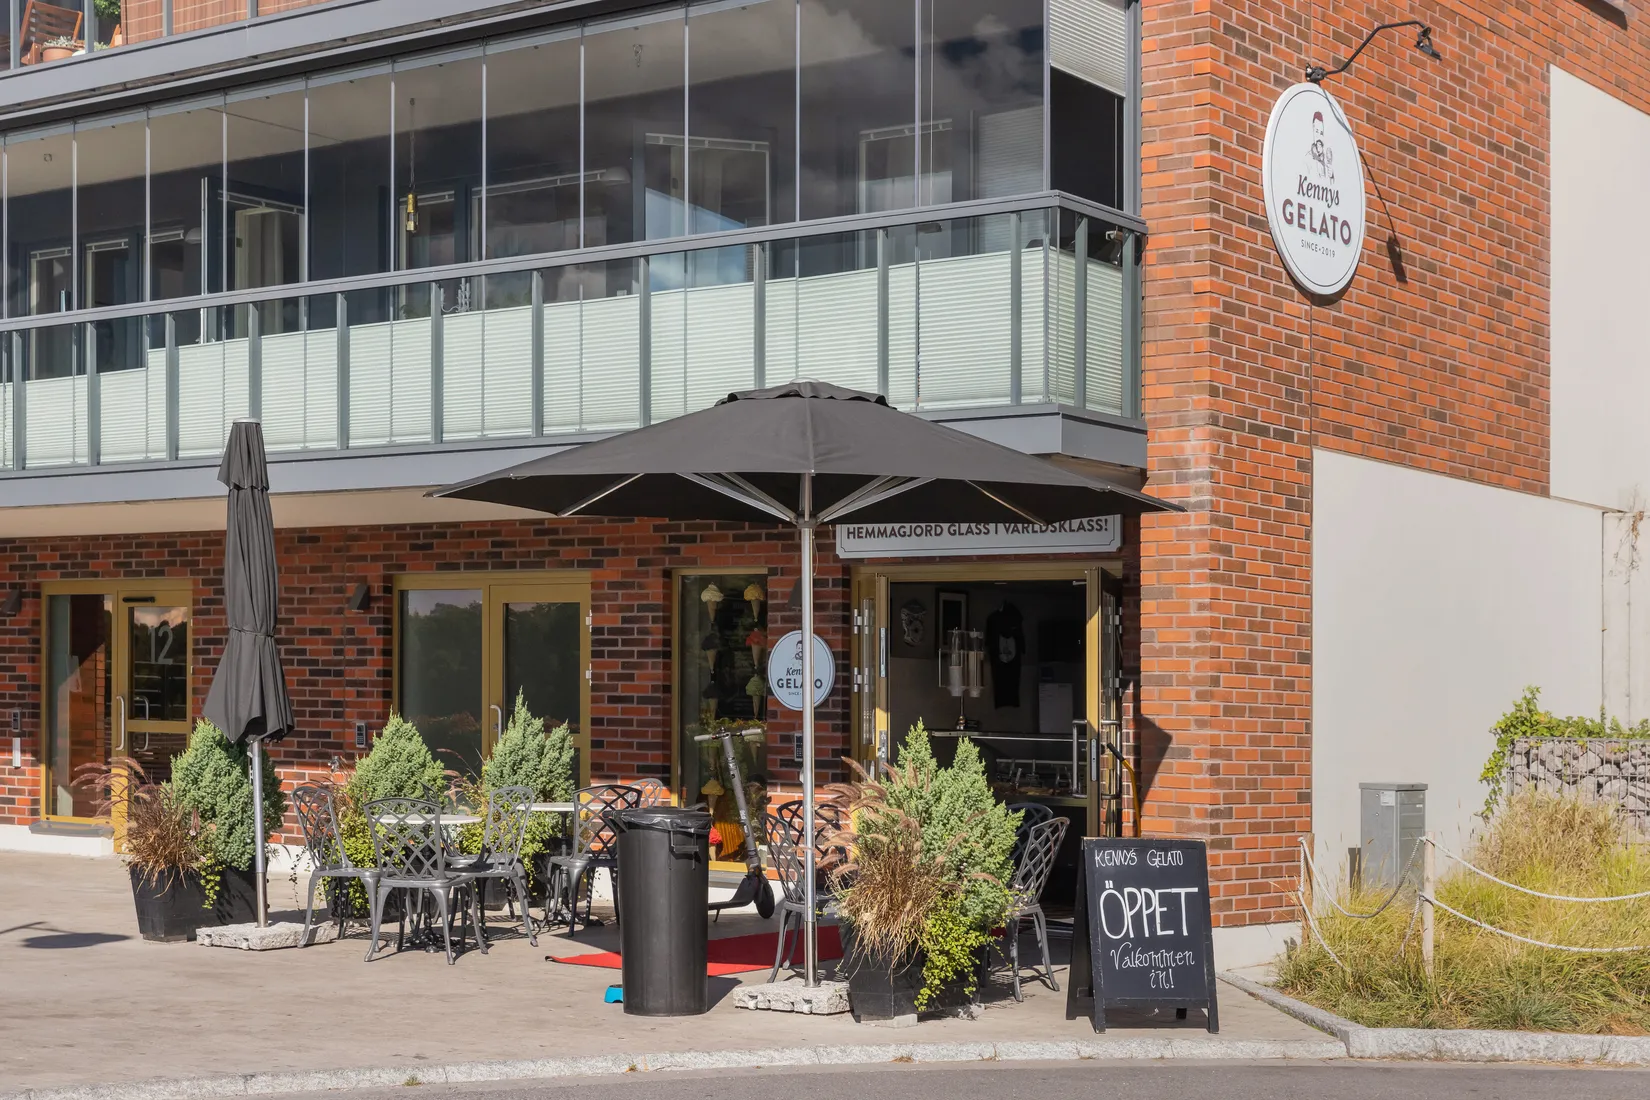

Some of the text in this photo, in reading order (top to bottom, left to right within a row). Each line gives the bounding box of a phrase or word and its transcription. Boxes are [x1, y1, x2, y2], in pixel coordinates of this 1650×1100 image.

[1297, 174, 1340, 209] Kennys
[1282, 198, 1352, 246] GELATO
[846, 524, 944, 540] HEMMAGJORD
[947, 522, 991, 537] GLASS
[147, 624, 173, 665] 12
[1146, 849, 1184, 869] GELATO
[1100, 879, 1199, 940] ÖPPET
[1110, 941, 1196, 970] Välkommen
[1149, 968, 1175, 989] in!
